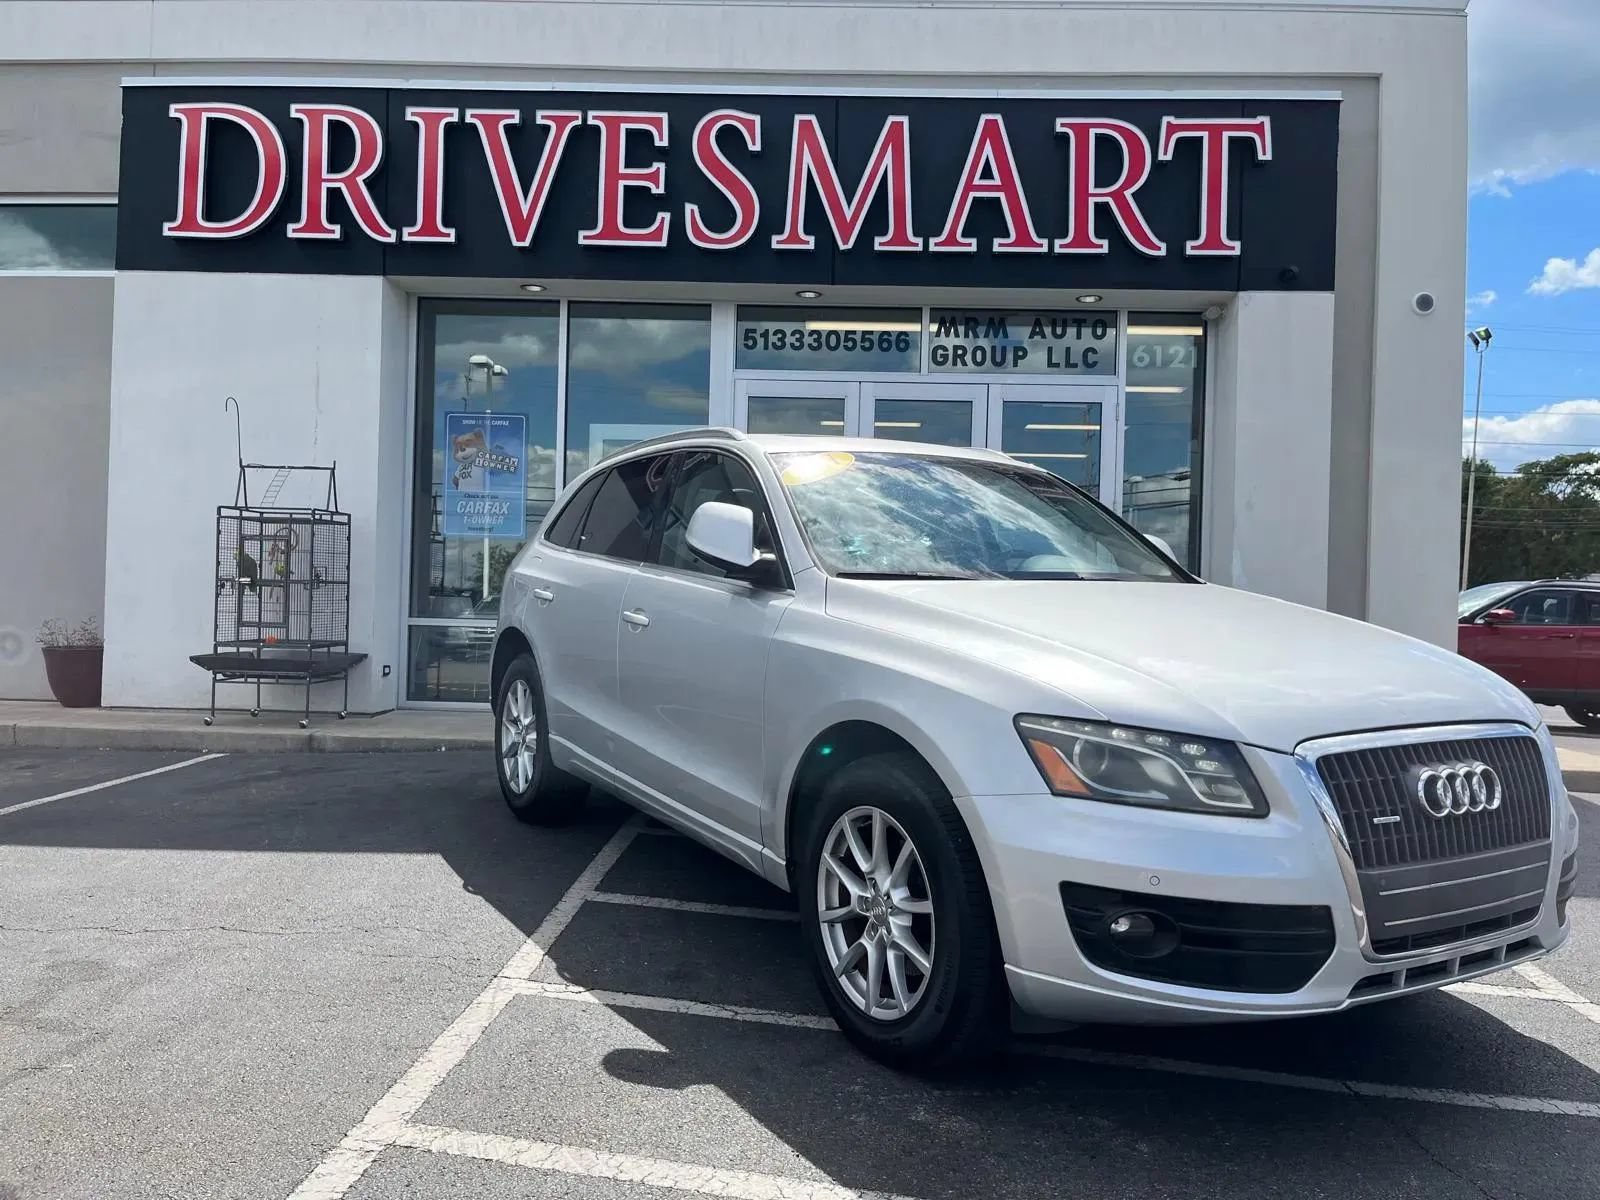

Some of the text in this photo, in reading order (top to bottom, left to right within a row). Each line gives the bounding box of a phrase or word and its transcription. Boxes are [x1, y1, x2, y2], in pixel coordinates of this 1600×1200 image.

[163, 102, 1272, 257] DRIVESMART
[743, 328, 910, 352] 5133305566
[935, 317, 1108, 341] MRM AUTO
[931, 344, 1099, 369] GROUP LLC
[1132, 344, 1198, 369] 6121
[457, 501, 510, 514] CARFAX
